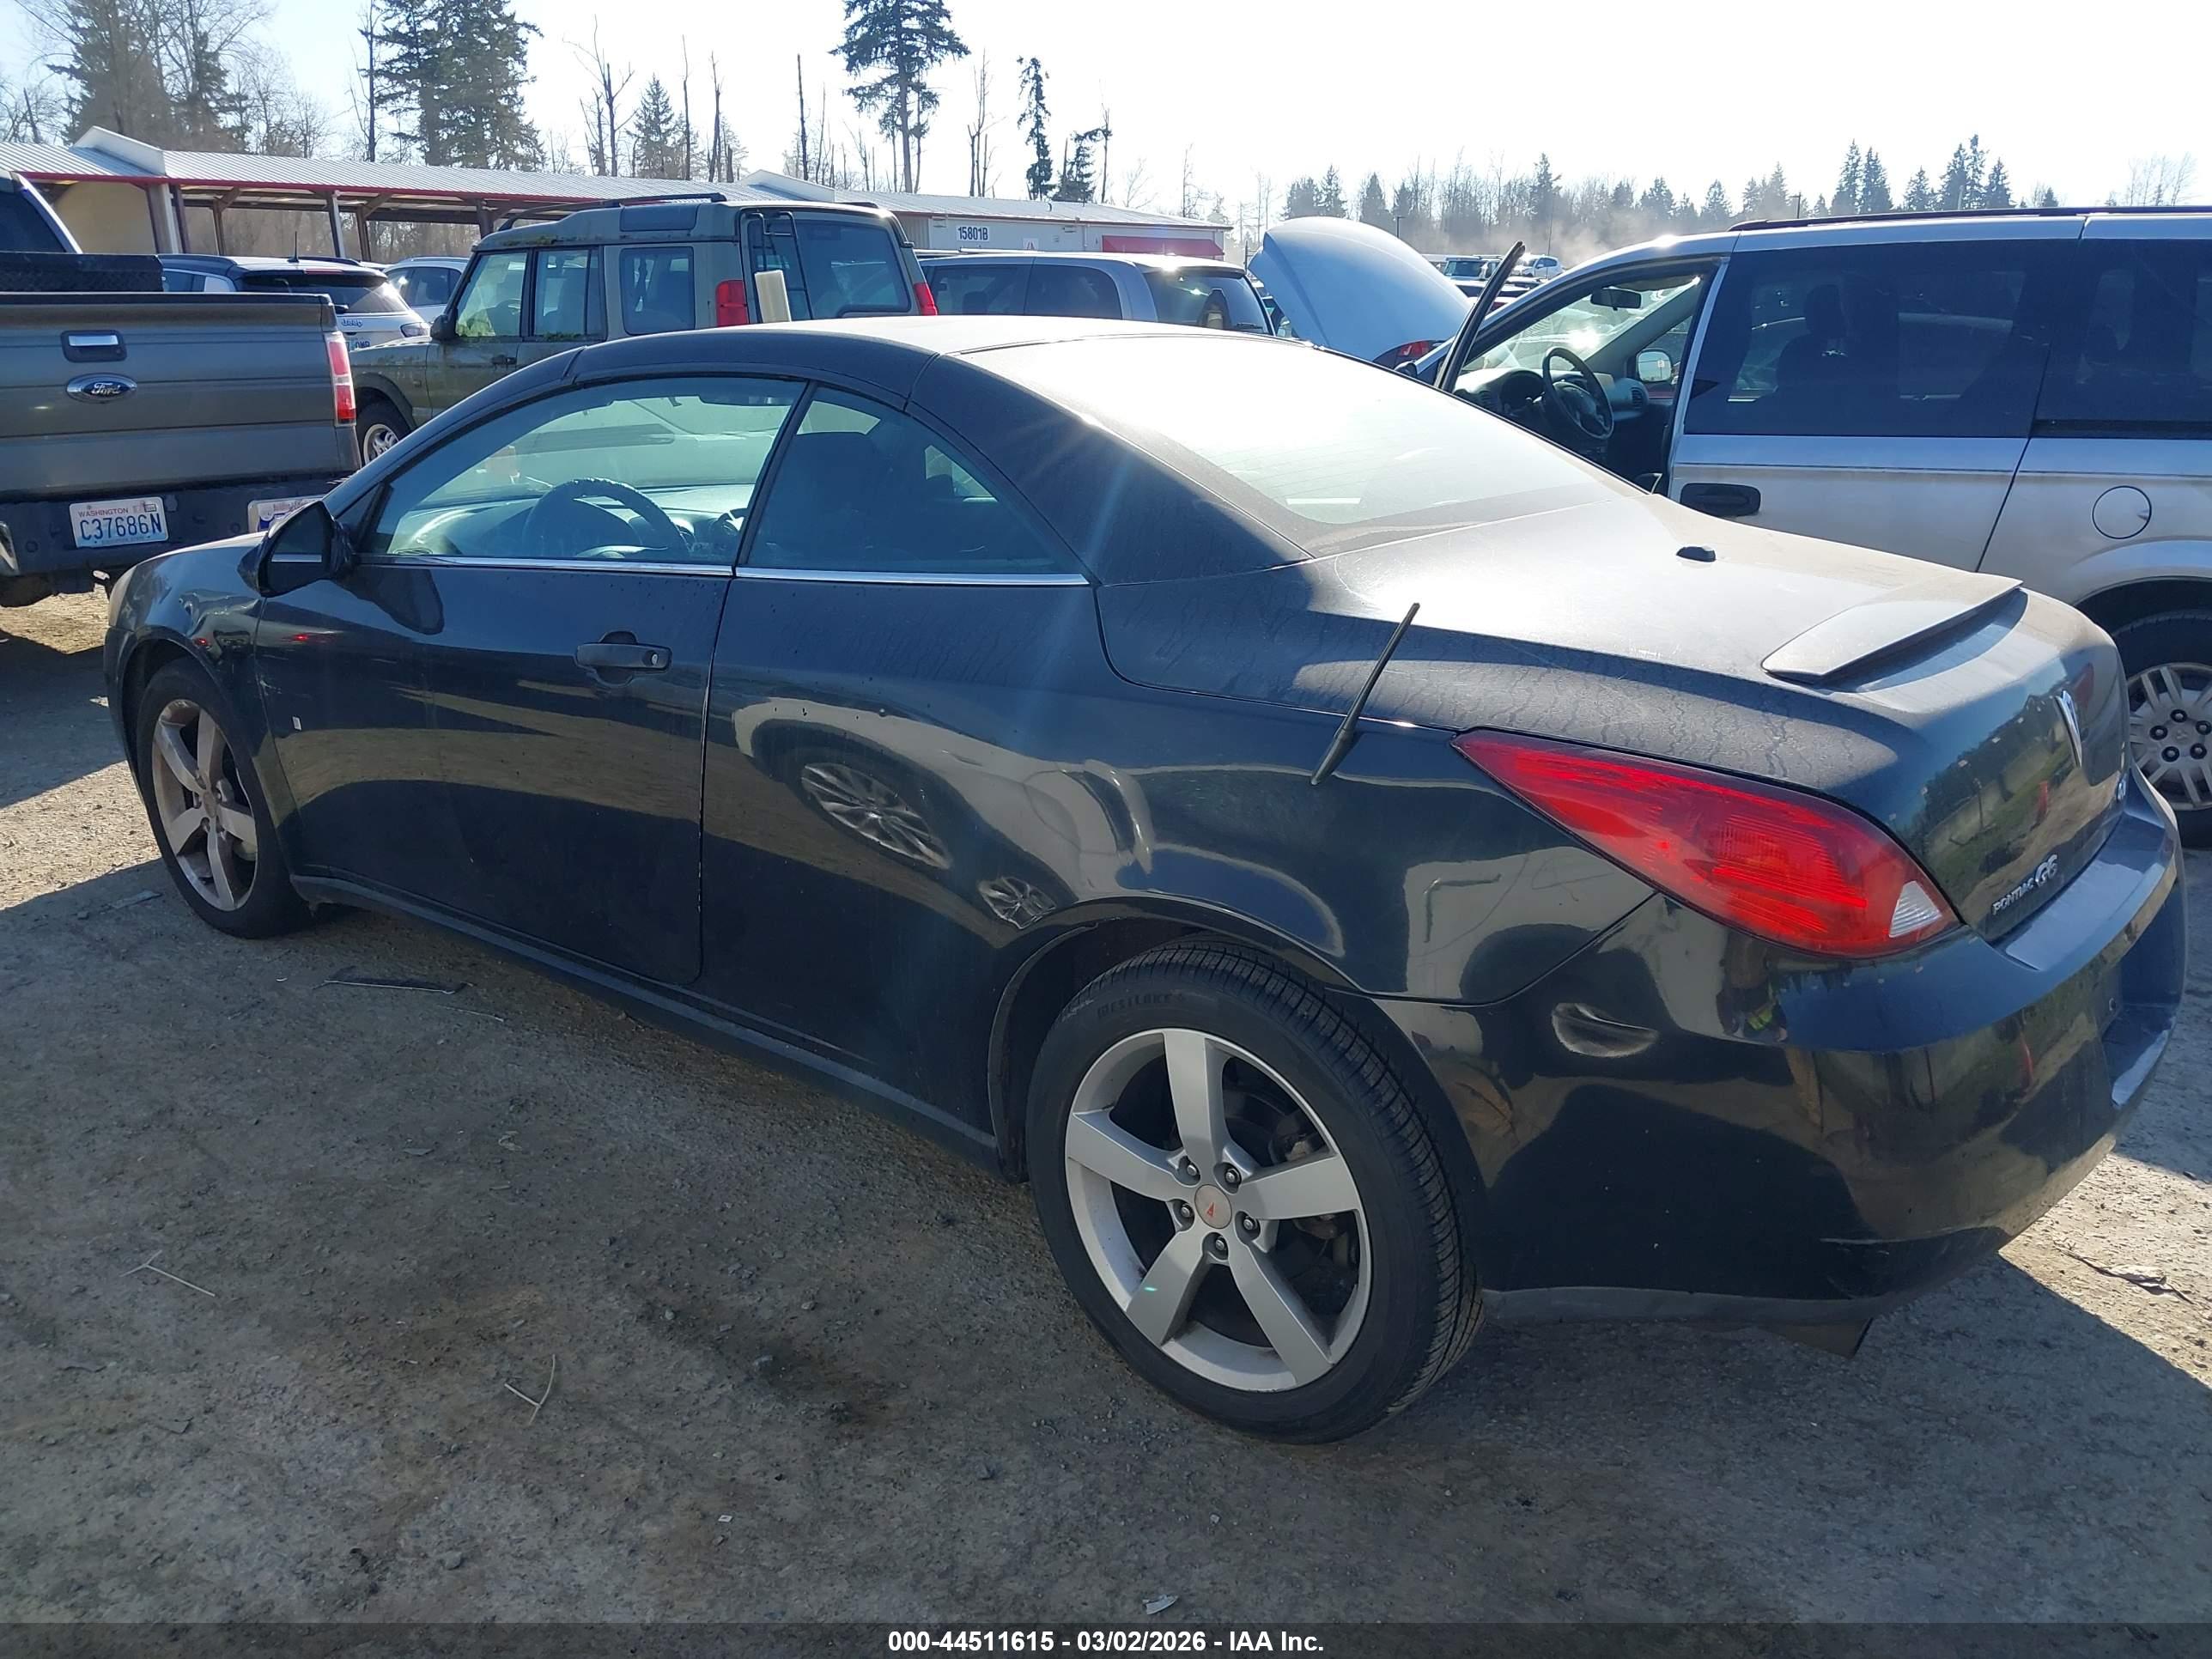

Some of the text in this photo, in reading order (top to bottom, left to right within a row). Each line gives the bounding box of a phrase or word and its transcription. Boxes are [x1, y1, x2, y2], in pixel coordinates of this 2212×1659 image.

[958, 227, 988, 240] 15801B
[342, 318, 363, 328] Jeep
[91, 382, 121, 395] Ford
[78, 507, 129, 518] WASHINGTON
[80, 513, 162, 540] C37686N
[1992, 854, 2058, 916] PONTIAC G6
